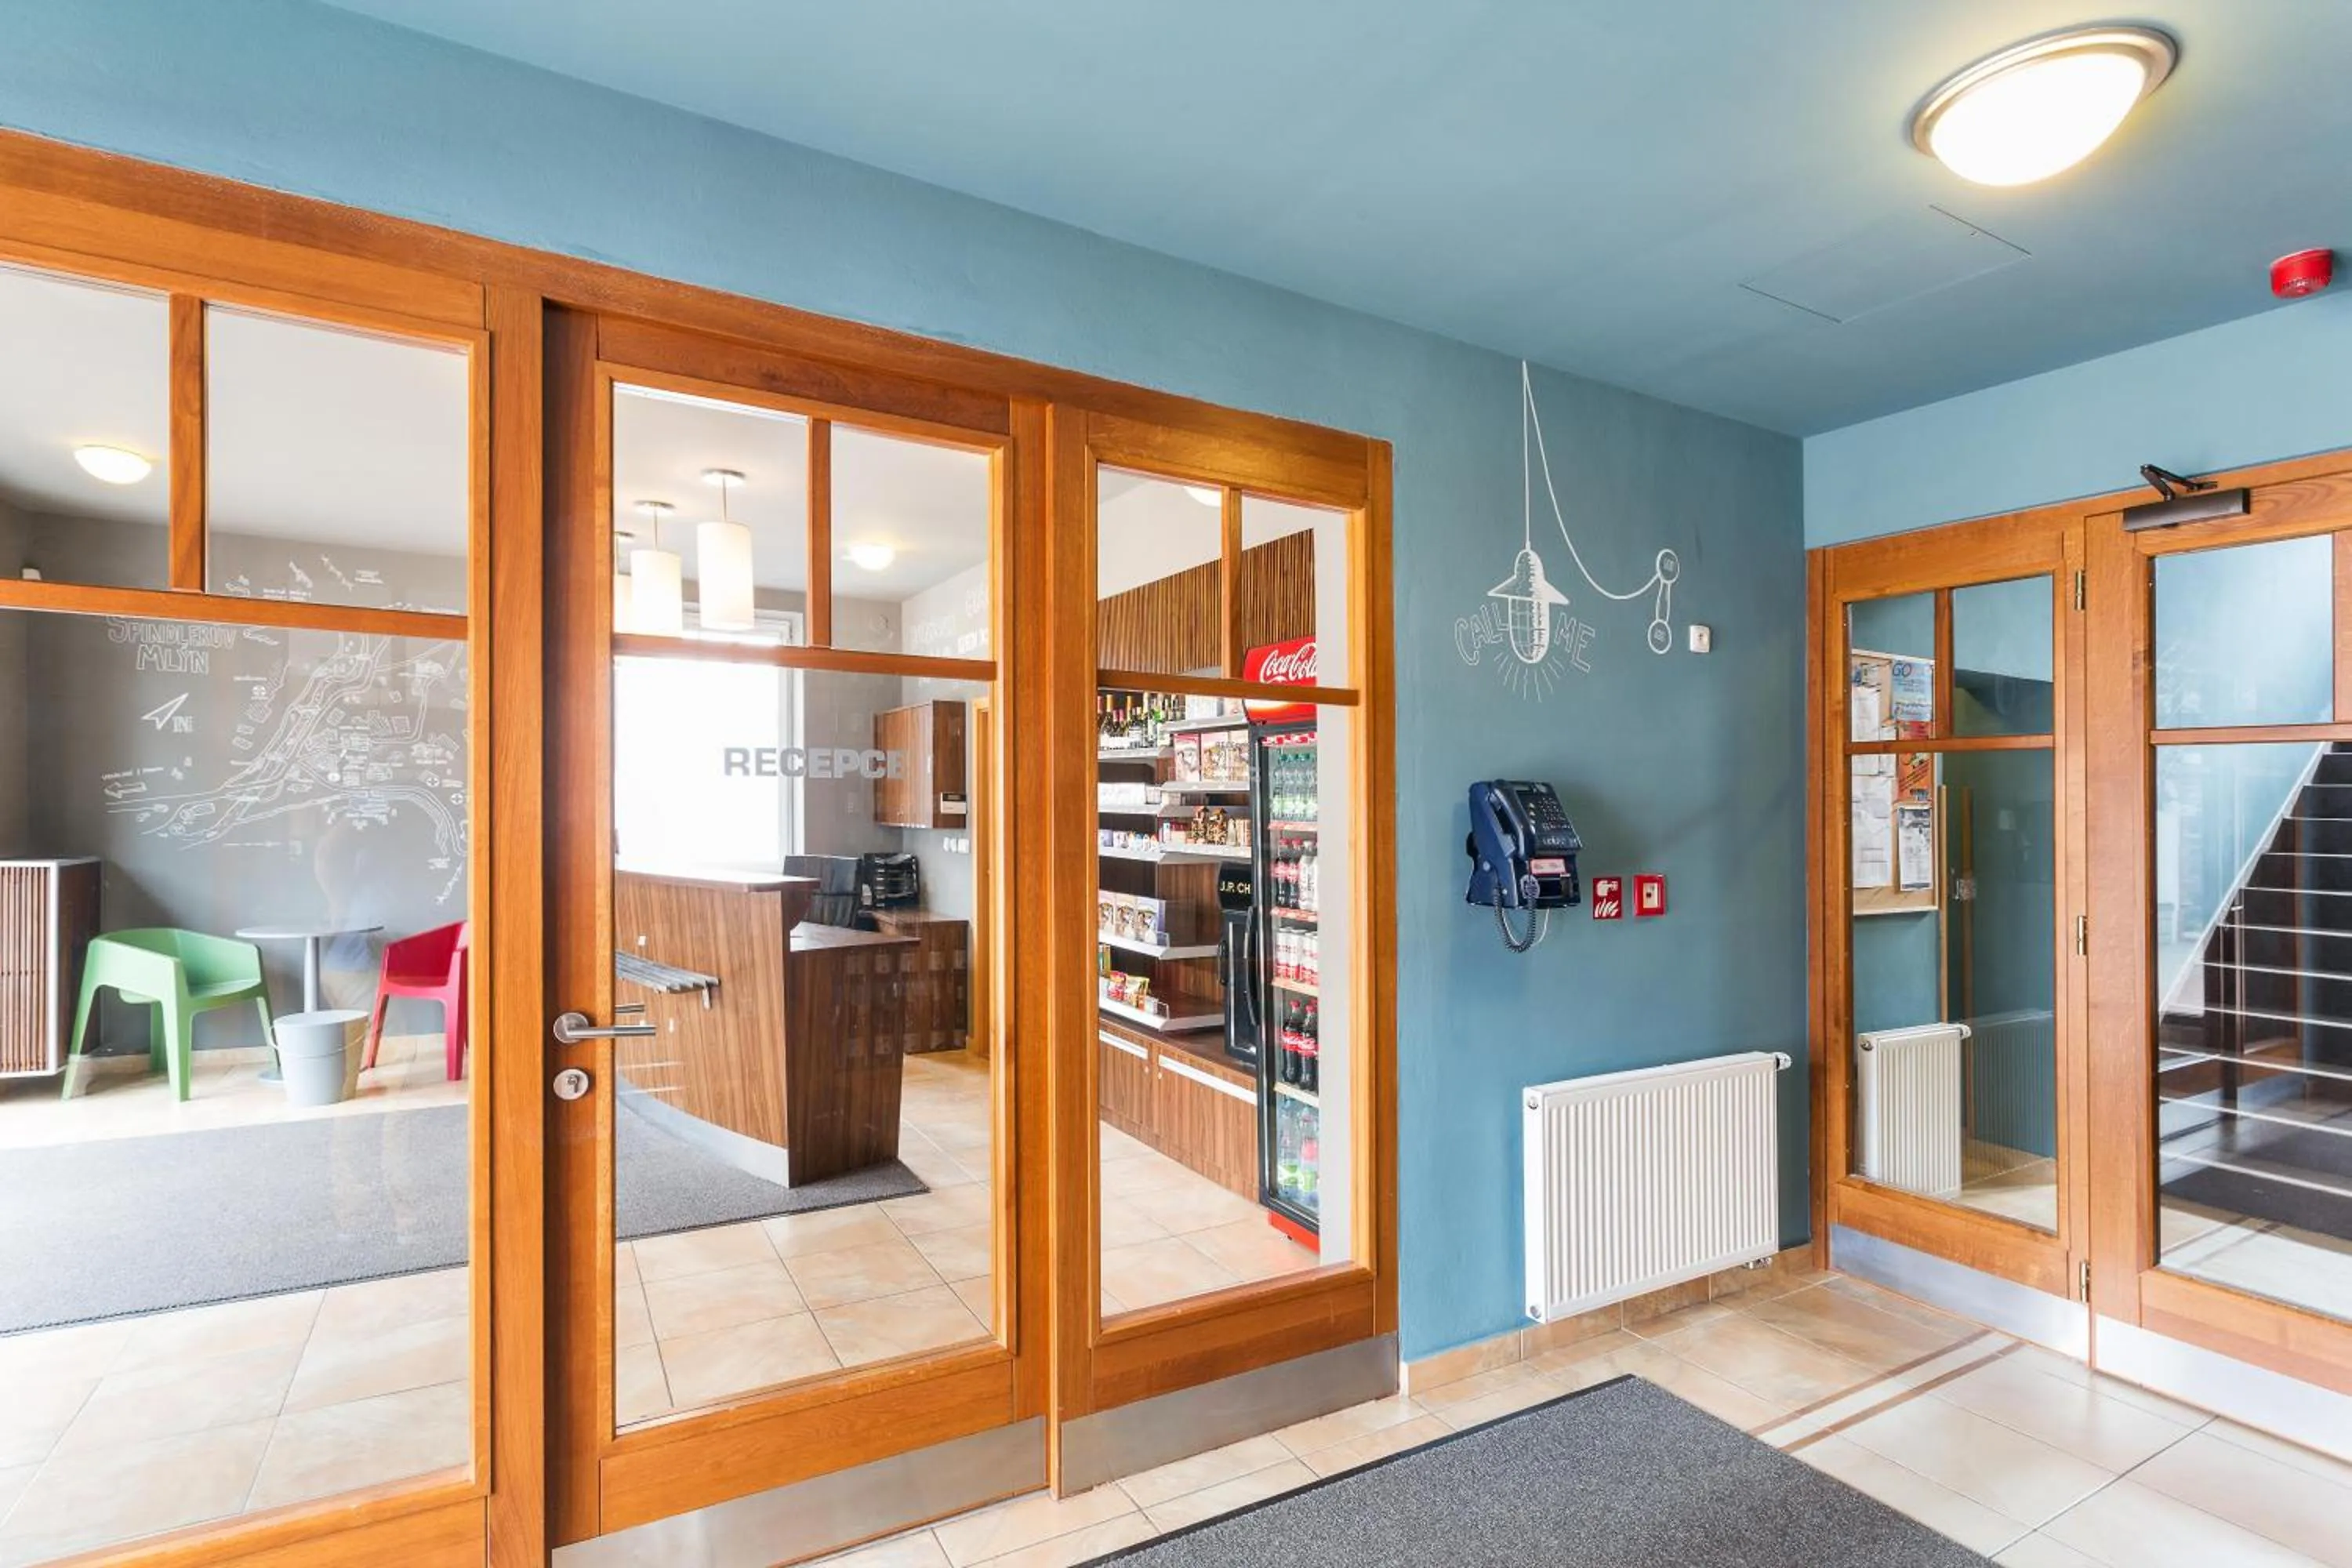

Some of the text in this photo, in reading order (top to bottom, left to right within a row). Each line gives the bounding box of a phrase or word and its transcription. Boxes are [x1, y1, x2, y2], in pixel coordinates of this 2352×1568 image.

[1454, 602, 1595, 673] CALL ME
[723, 746, 906, 780] RECEPCE
